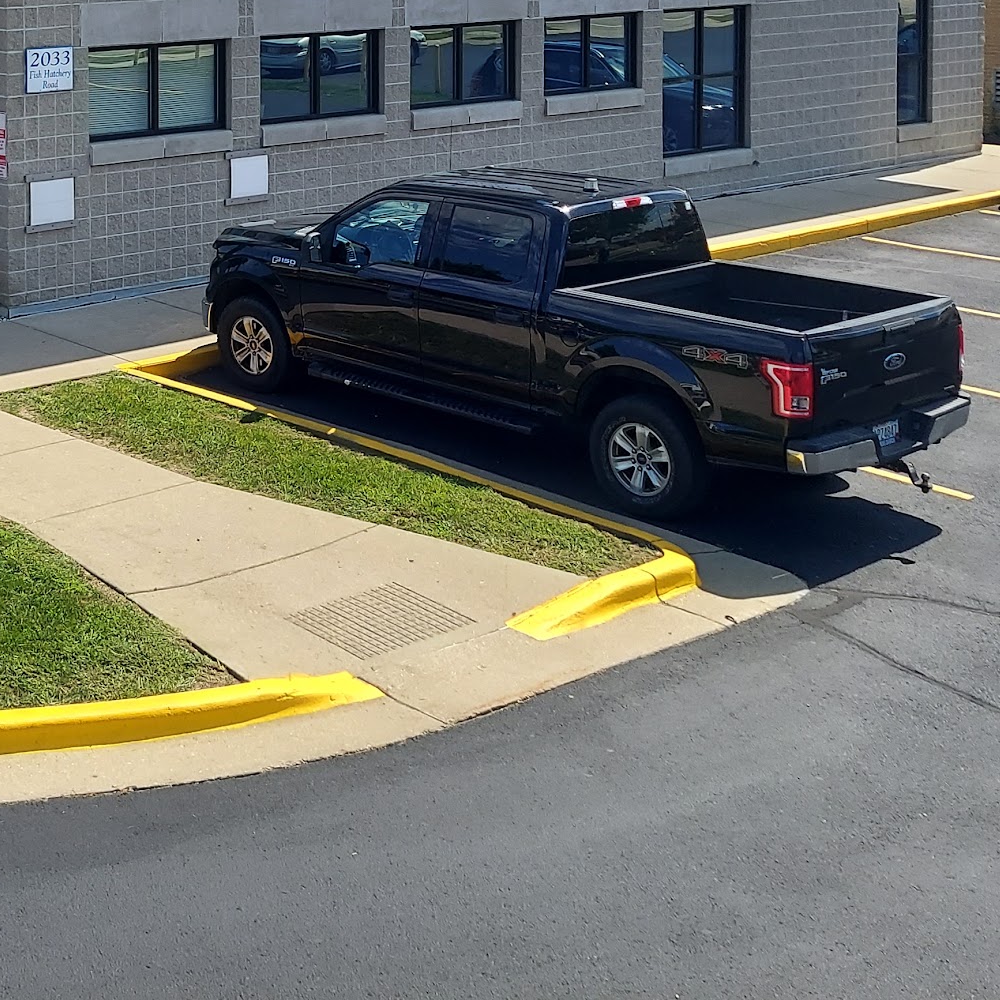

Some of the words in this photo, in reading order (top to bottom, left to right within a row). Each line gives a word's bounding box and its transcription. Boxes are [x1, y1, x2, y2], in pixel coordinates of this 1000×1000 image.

[30, 51, 70, 67] 2033
[29, 70, 43, 79] Fish
[44, 68, 71, 79] Hatchery
[43, 79, 58, 89] Road
